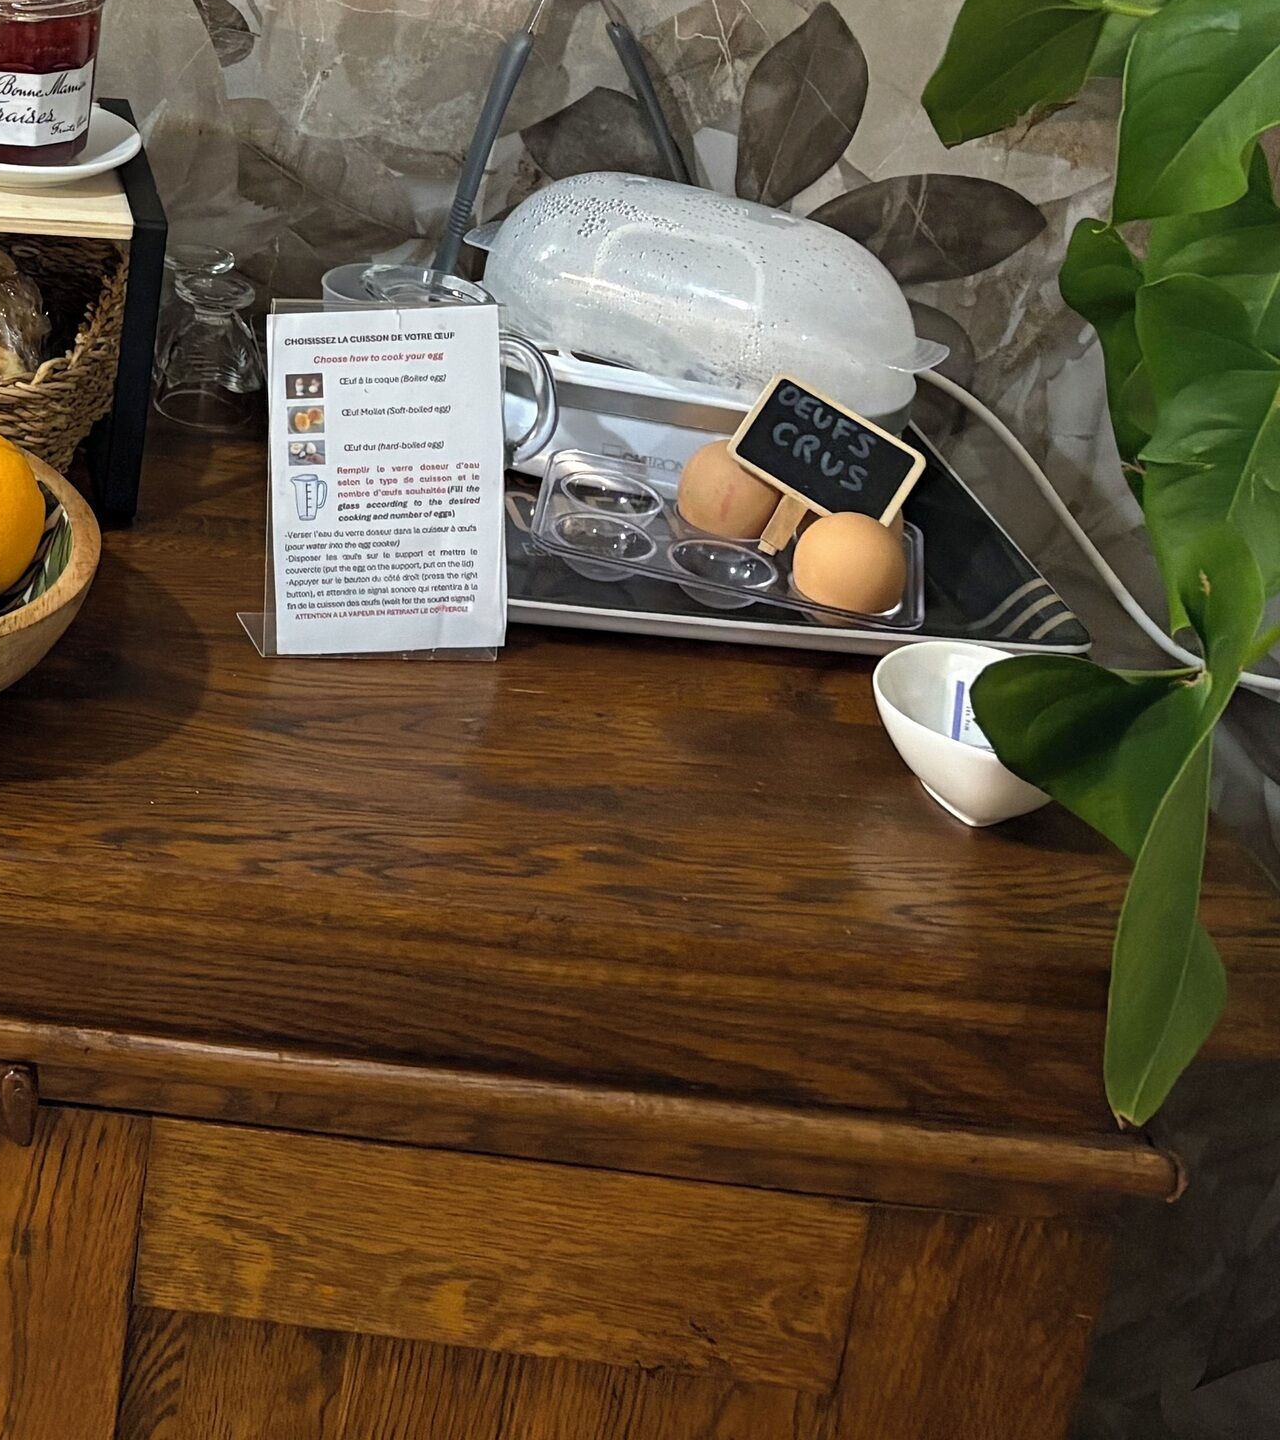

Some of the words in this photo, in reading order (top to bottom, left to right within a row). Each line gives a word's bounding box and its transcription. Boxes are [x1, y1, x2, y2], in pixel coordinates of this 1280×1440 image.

[284, 337, 336, 346] CHOISISSEZ
[350, 334, 389, 343] CUISSON
[391, 334, 402, 342] DE
[404, 332, 432, 340] VOTRE
[314, 355, 348, 364] Choose
[350, 354, 368, 362] how
[370, 354, 380, 362] to
[382, 352, 404, 362] cook
[404, 353, 426, 362] your
[427, 352, 444, 361] egg
[778, 386, 877, 459] OEUFS
[772, 422, 868, 492] CRUS
[366, 500, 408, 509] according
[338, 514, 372, 522] cooking
[372, 512, 388, 520] and
[390, 511, 422, 520] number
